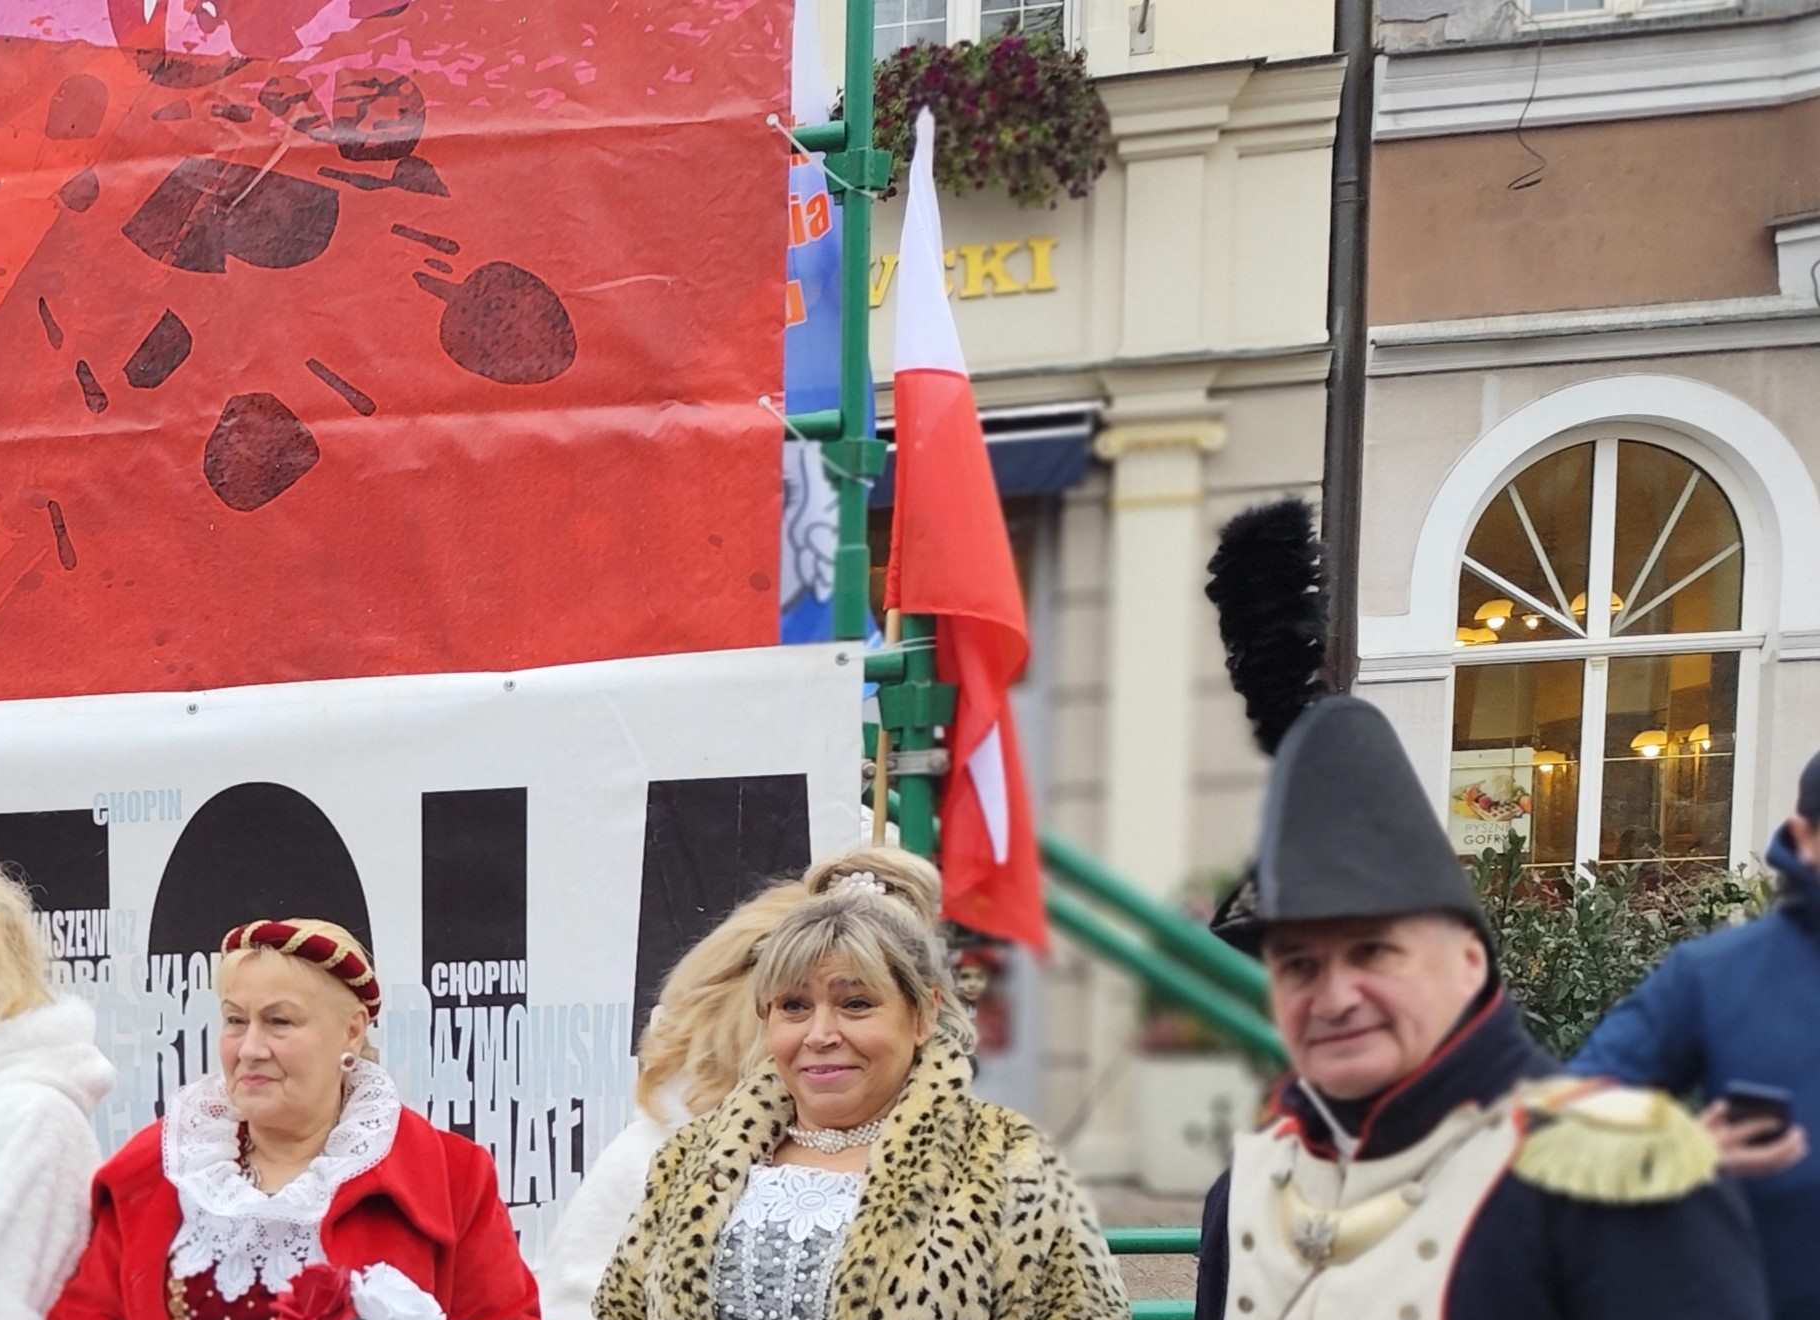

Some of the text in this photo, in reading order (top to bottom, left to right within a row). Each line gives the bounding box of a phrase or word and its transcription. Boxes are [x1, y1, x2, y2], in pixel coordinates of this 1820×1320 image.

[92, 789, 182, 826] CHOPIN
[1463, 834, 1509, 845] GOFRY
[431, 960, 526, 997] CHOPIN
